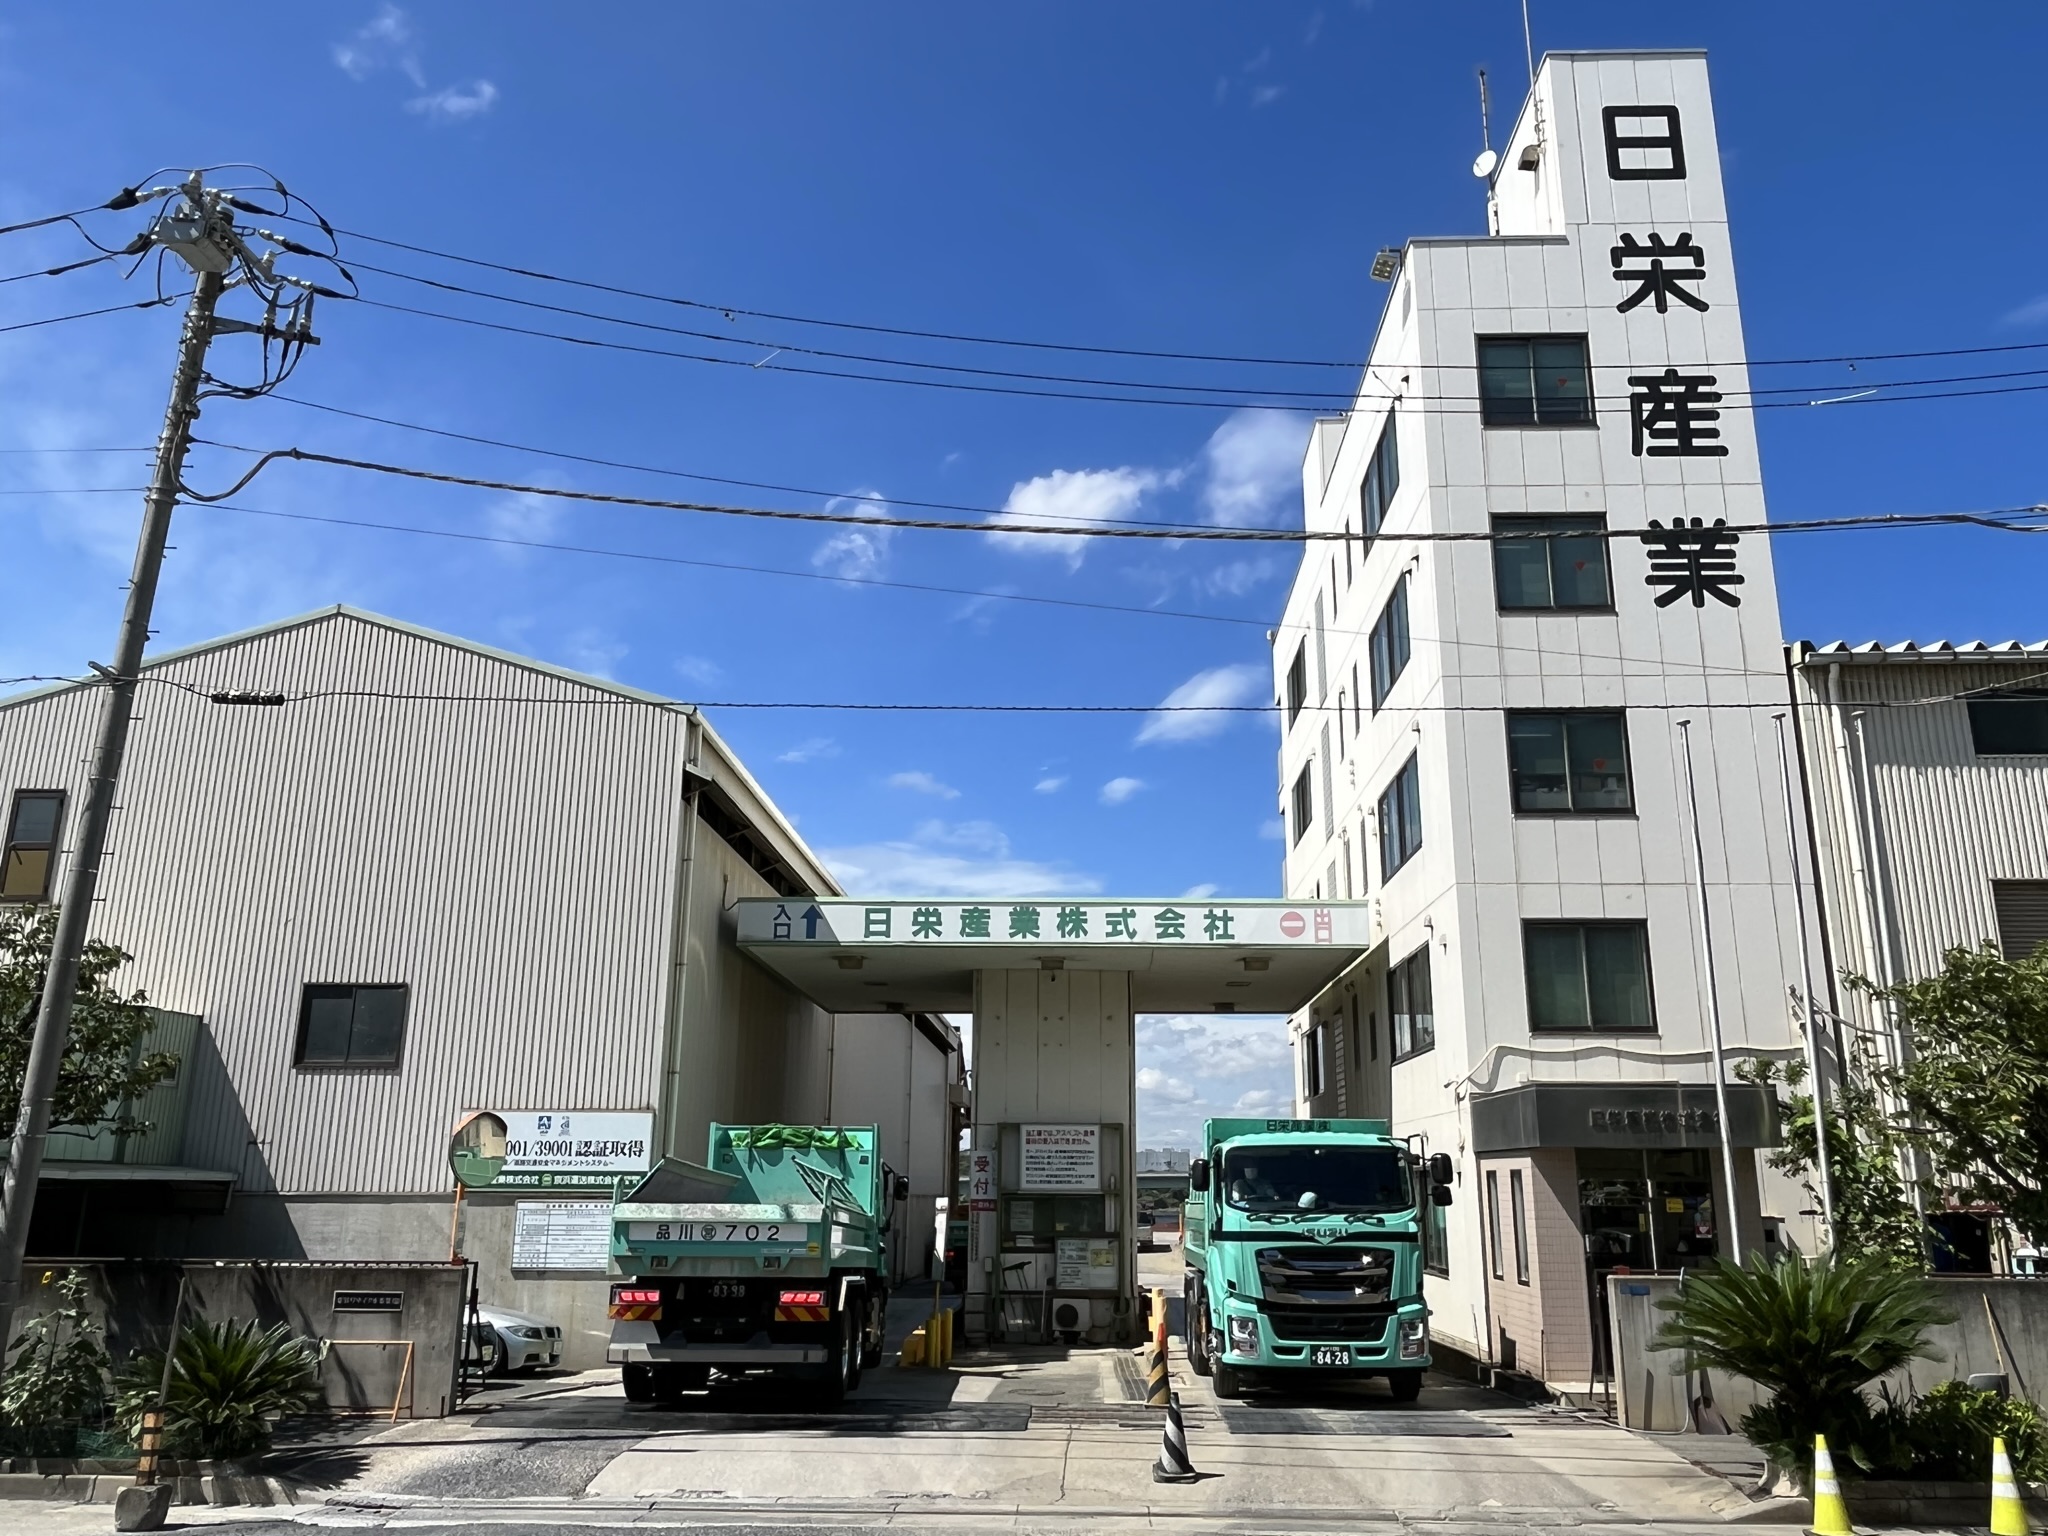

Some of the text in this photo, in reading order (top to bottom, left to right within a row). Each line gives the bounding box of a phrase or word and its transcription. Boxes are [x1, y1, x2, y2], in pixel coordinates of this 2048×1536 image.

[1602, 105, 1745, 608] 日栄産業
[772, 903, 792, 940] 入口
[863, 906, 1236, 941] 日栄産業株式会社
[1313, 907, 1333, 944] 出口
[974, 1155, 990, 1195] 受付
[1301, 1227, 1349, 1238] ISUZU
